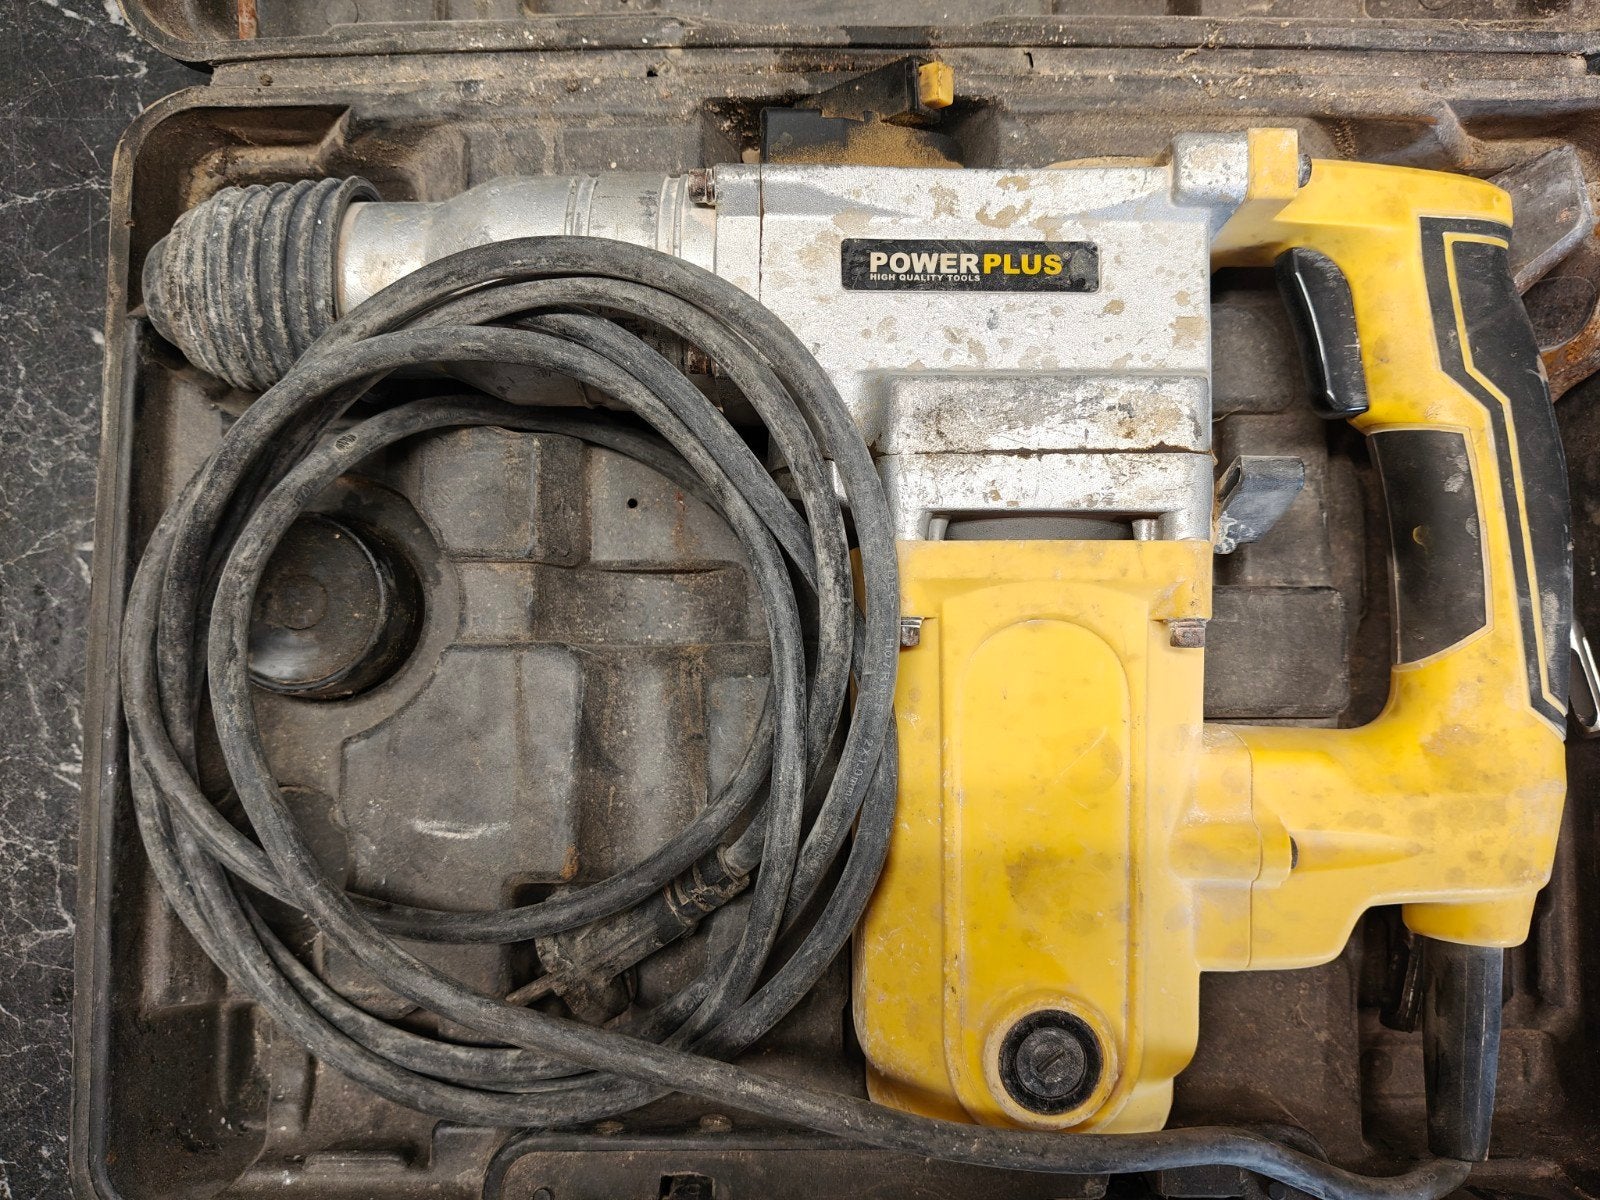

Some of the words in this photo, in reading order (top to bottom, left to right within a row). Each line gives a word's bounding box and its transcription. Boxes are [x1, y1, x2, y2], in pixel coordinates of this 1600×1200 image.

[870, 273, 896, 281] HIGH
[899, 274, 943, 282] QUALITY
[946, 274, 981, 282] TOOLS
